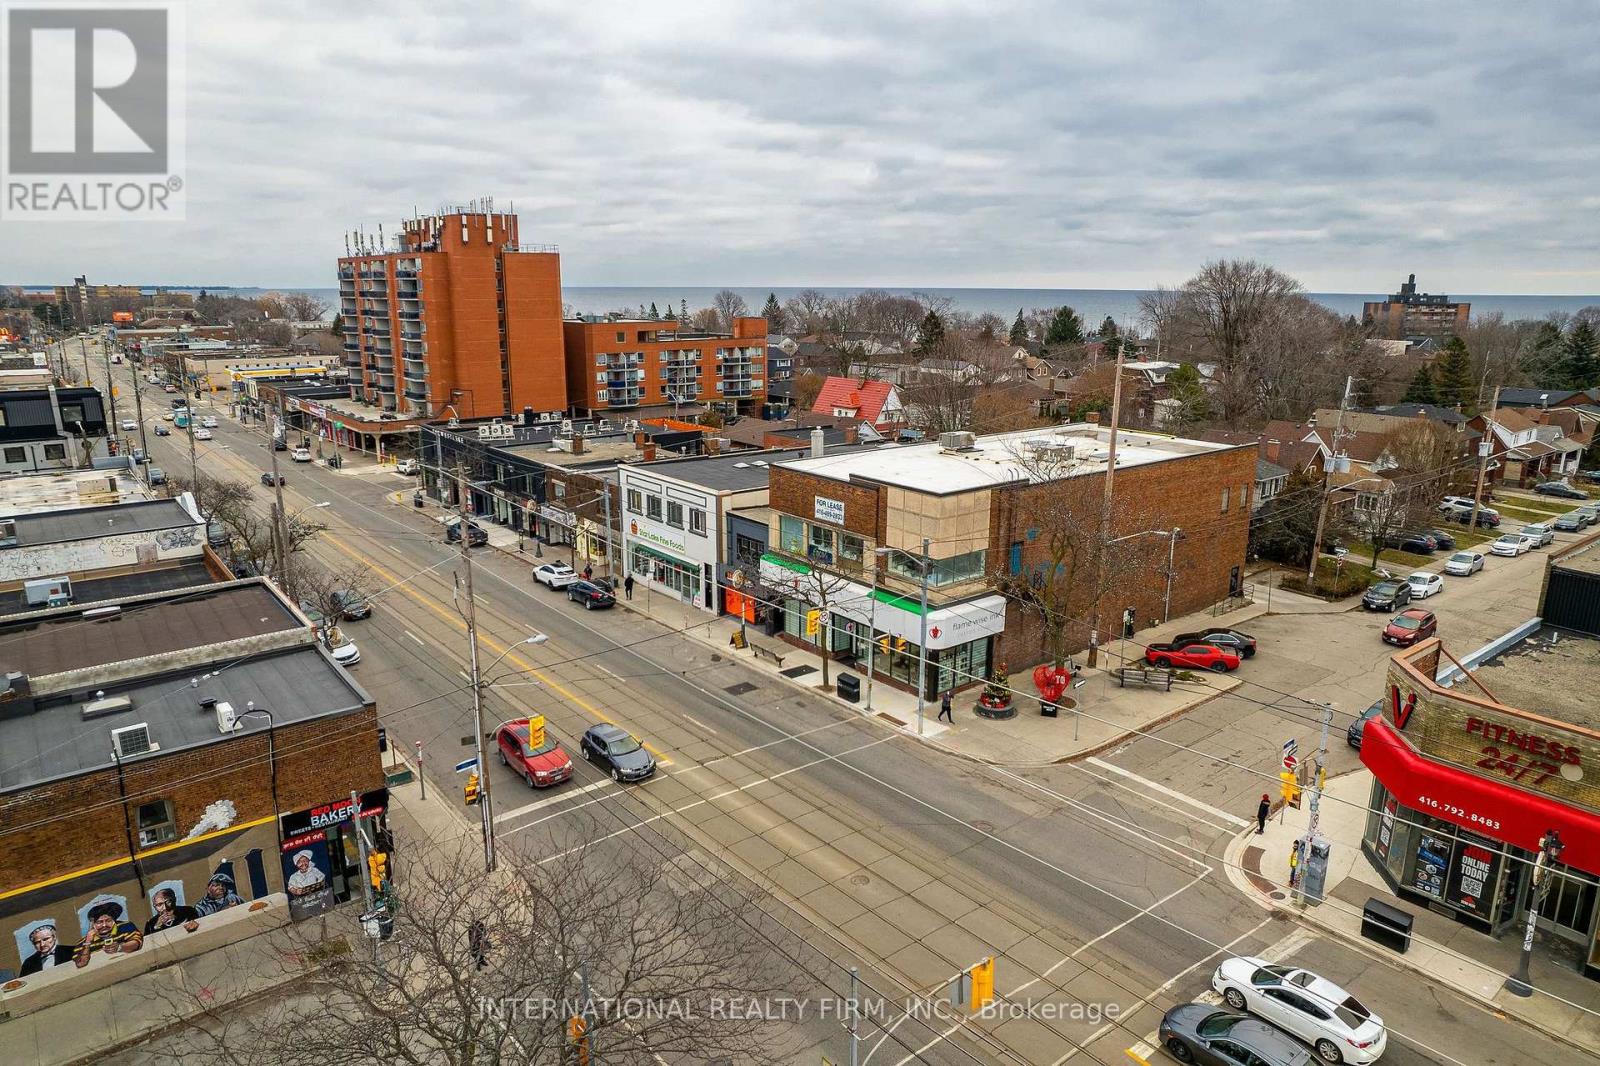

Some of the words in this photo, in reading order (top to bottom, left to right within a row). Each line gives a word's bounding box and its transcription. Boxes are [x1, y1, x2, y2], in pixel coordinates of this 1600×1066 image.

[816, 498, 827, 508] FOR
[827, 501, 843, 512] LEASE
[649, 532, 660, 542] Lake
[660, 535, 669, 546] Fine
[669, 539, 685, 552] Foods
[1464, 716, 1582, 767] FITNESS
[1474, 745, 1561, 786] 24/7
[310, 805, 331, 817] RED
[1418, 795, 1501, 831] 416.792.8483
[1461, 863, 1489, 882] TODAY
[1462, 855, 1490, 873] ONLINE
